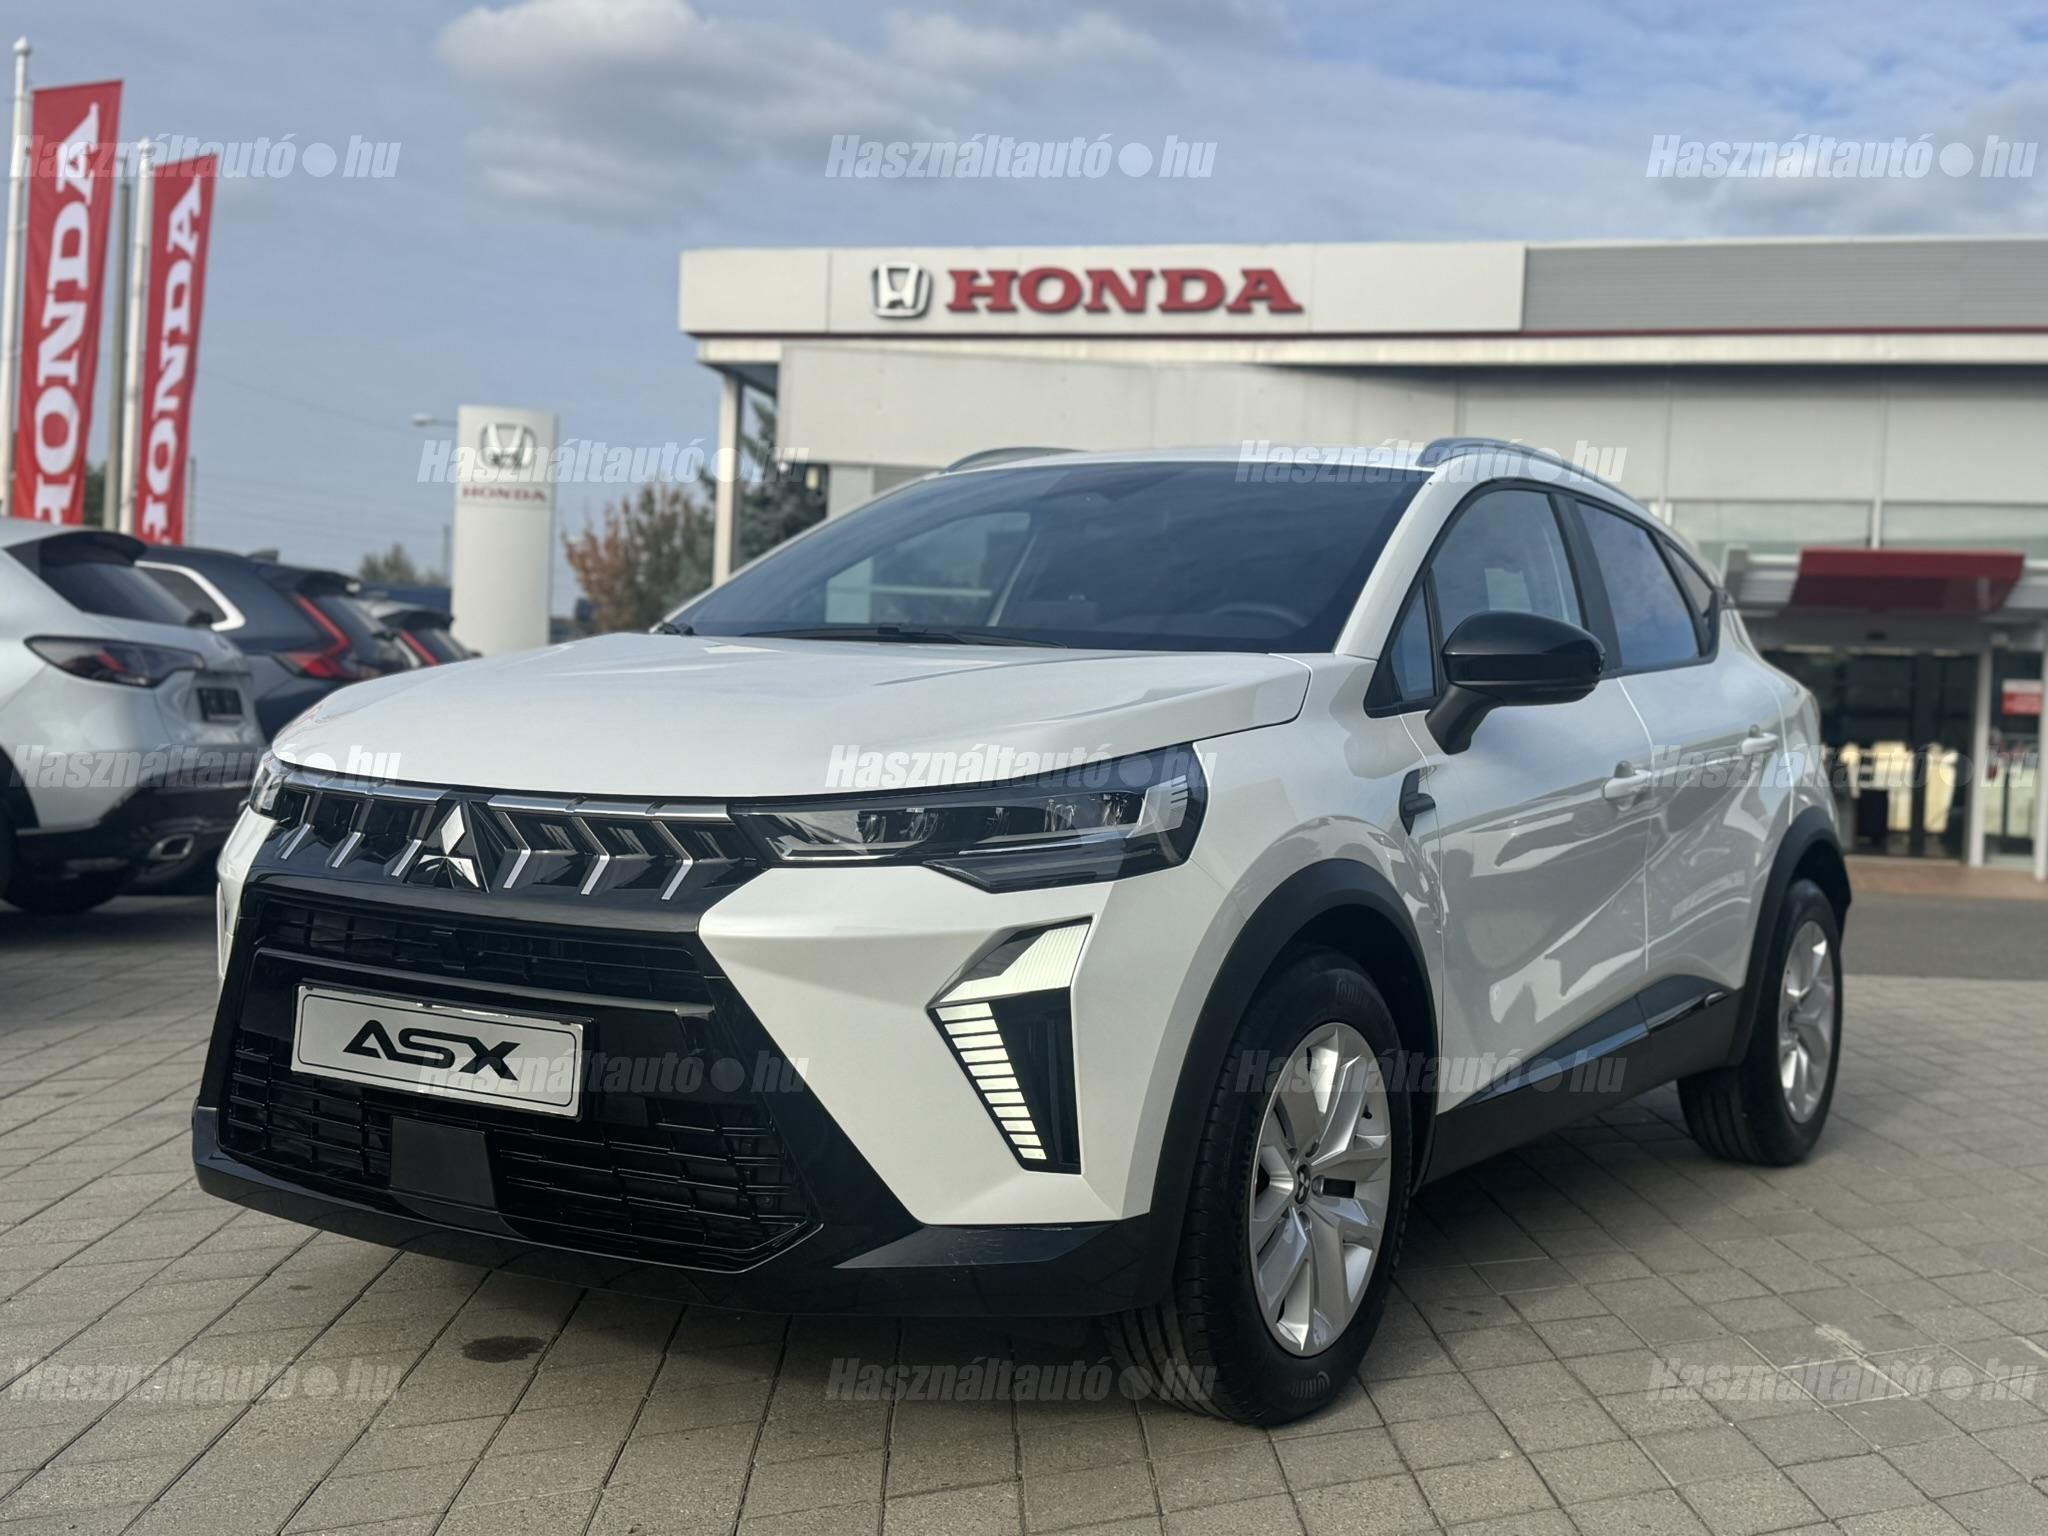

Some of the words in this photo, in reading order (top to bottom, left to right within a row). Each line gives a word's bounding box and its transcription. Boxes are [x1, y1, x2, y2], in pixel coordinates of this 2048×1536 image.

[946, 266, 1304, 314] HONDA
[462, 485, 547, 503] HONDA
[342, 1019, 521, 1081] ASX
